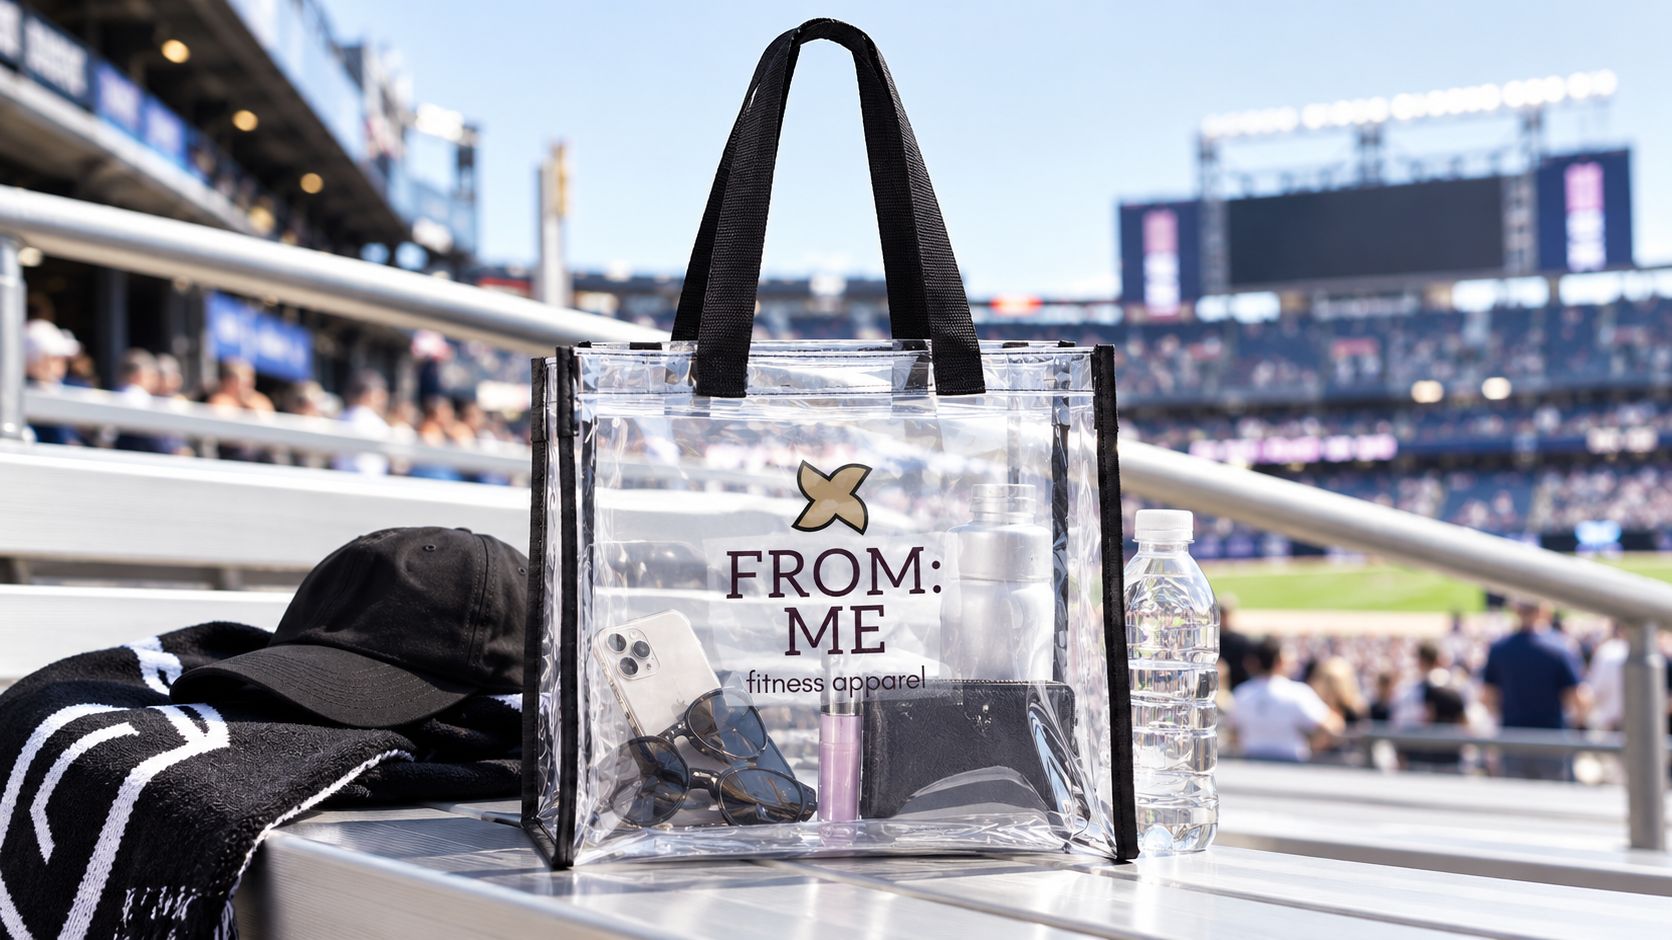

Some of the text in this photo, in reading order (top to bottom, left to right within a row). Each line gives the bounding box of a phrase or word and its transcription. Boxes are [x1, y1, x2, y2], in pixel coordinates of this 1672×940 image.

[726, 546, 942, 599] FROM:
[784, 604, 885, 656] ME
[746, 665, 926, 699] fitness apparel
